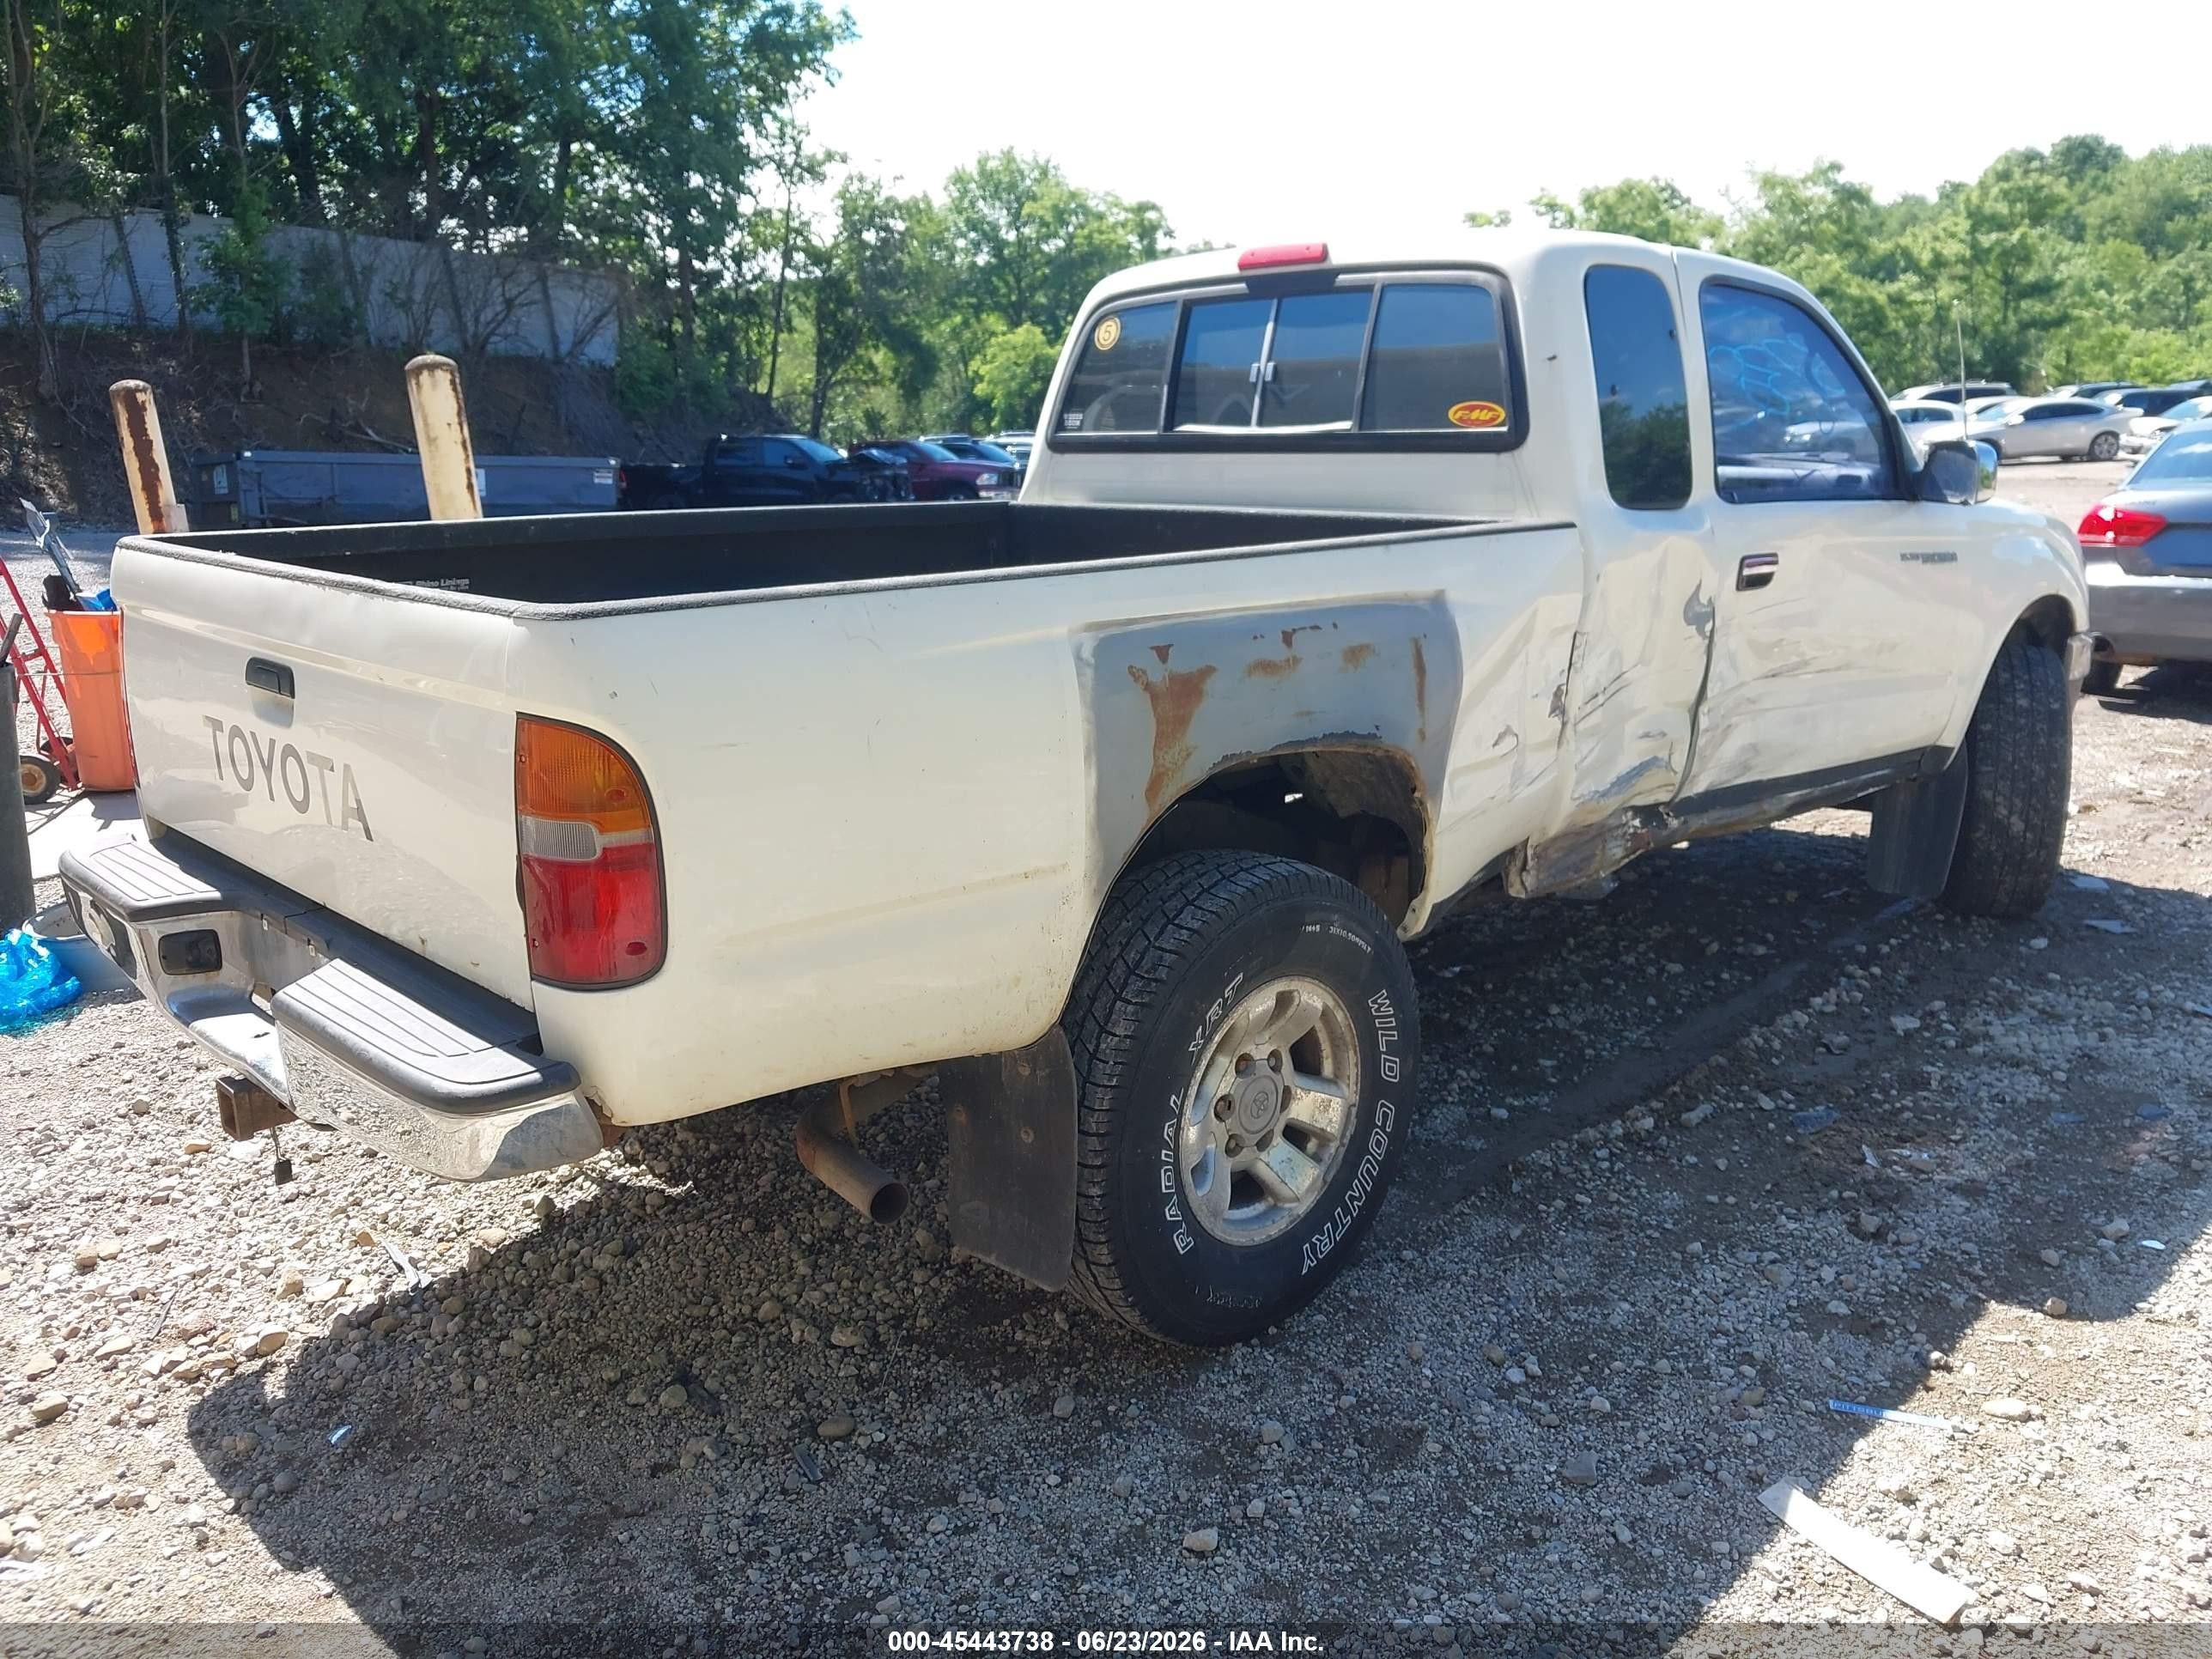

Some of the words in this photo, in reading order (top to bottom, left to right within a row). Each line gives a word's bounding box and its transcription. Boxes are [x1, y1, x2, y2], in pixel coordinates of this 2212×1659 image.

[1102, 324, 1113, 342] 5
[203, 714, 374, 842] TOYOTA
[1368, 989, 1400, 1083] WILD
[1161, 1086, 1195, 1255] RADIAL
[1301, 1099, 1395, 1275] COUNTRY
